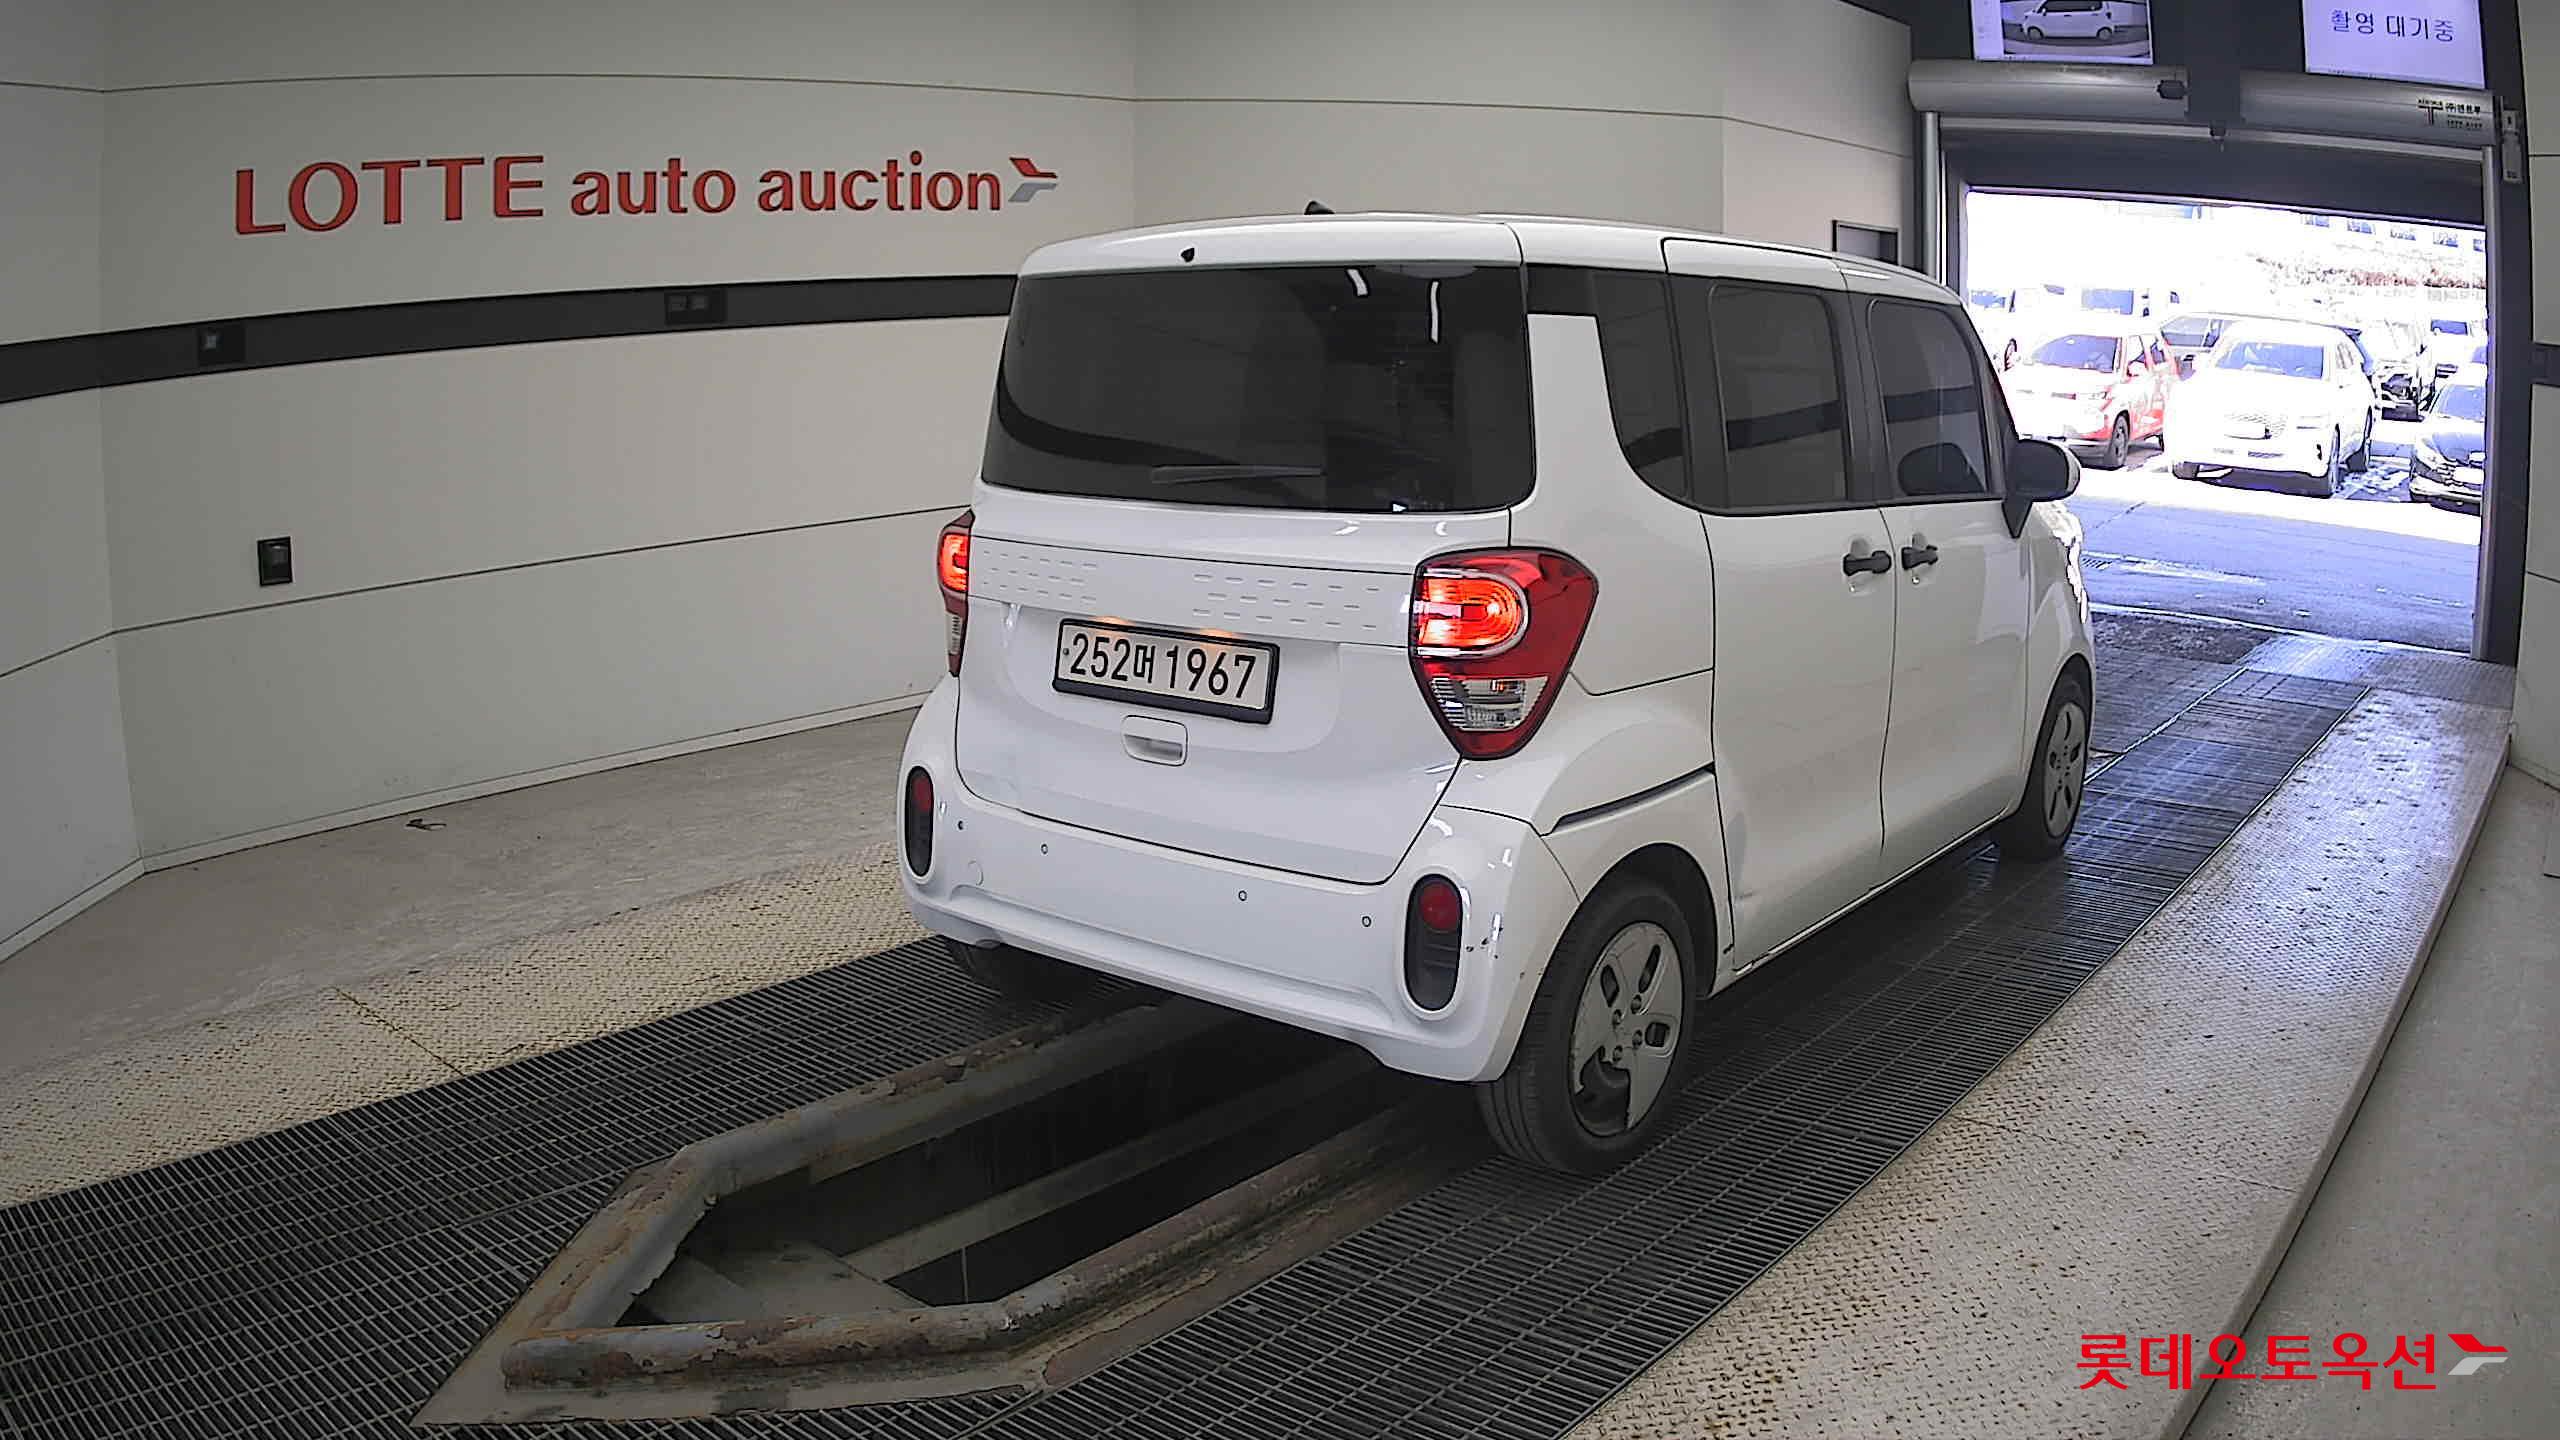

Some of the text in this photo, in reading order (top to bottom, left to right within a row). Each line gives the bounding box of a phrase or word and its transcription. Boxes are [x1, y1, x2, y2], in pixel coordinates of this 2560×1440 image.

[2331, 9, 2453, 42] 촬영 대기중
[235, 150, 1001, 235] LOTTE auto auction
[1070, 632, 1256, 699] 252머 1967
